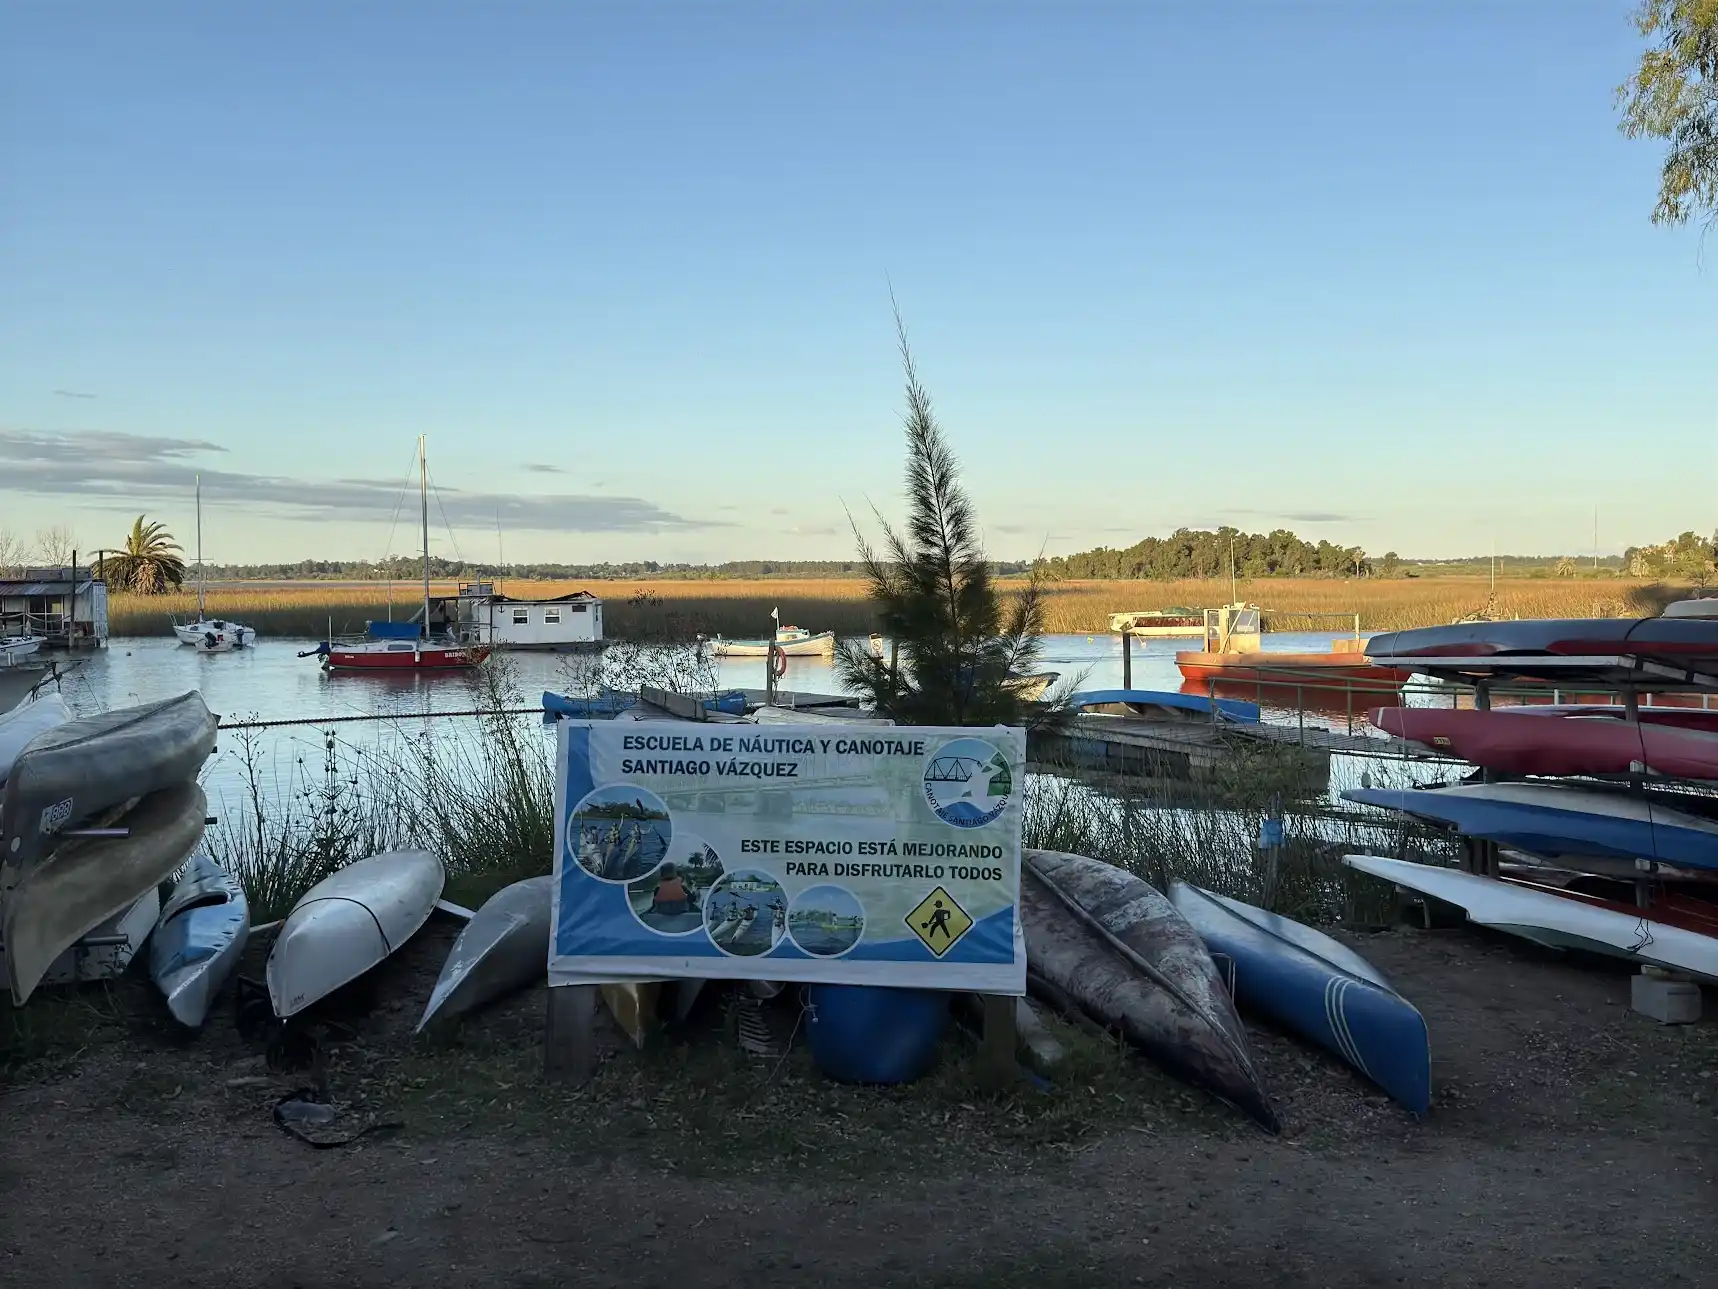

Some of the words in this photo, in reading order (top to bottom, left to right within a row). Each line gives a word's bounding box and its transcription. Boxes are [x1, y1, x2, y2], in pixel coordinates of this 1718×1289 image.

[623, 735, 704, 751] ESCUELA
[709, 737, 734, 752] DE
[738, 734, 815, 754] NÁUTICA
[819, 740, 831, 754] Y
[835, 739, 924, 756] CANOTAJE
[621, 759, 711, 775] SANTIAGO
[715, 757, 798, 779] VÁZQUEZ
[924, 782, 948, 819] CANOTAJE
[948, 815, 989, 826] SANTIAGO
[741, 839, 780, 853] ESTE
[784, 840, 853, 855] ESPACIO
[857, 838, 898, 856] ESTÁ
[902, 842, 1003, 859] MEJORANDO
[785, 862, 830, 876] PARA
[834, 863, 945, 878] DISFRUTARLO
[948, 865, 1003, 881] TODOS
